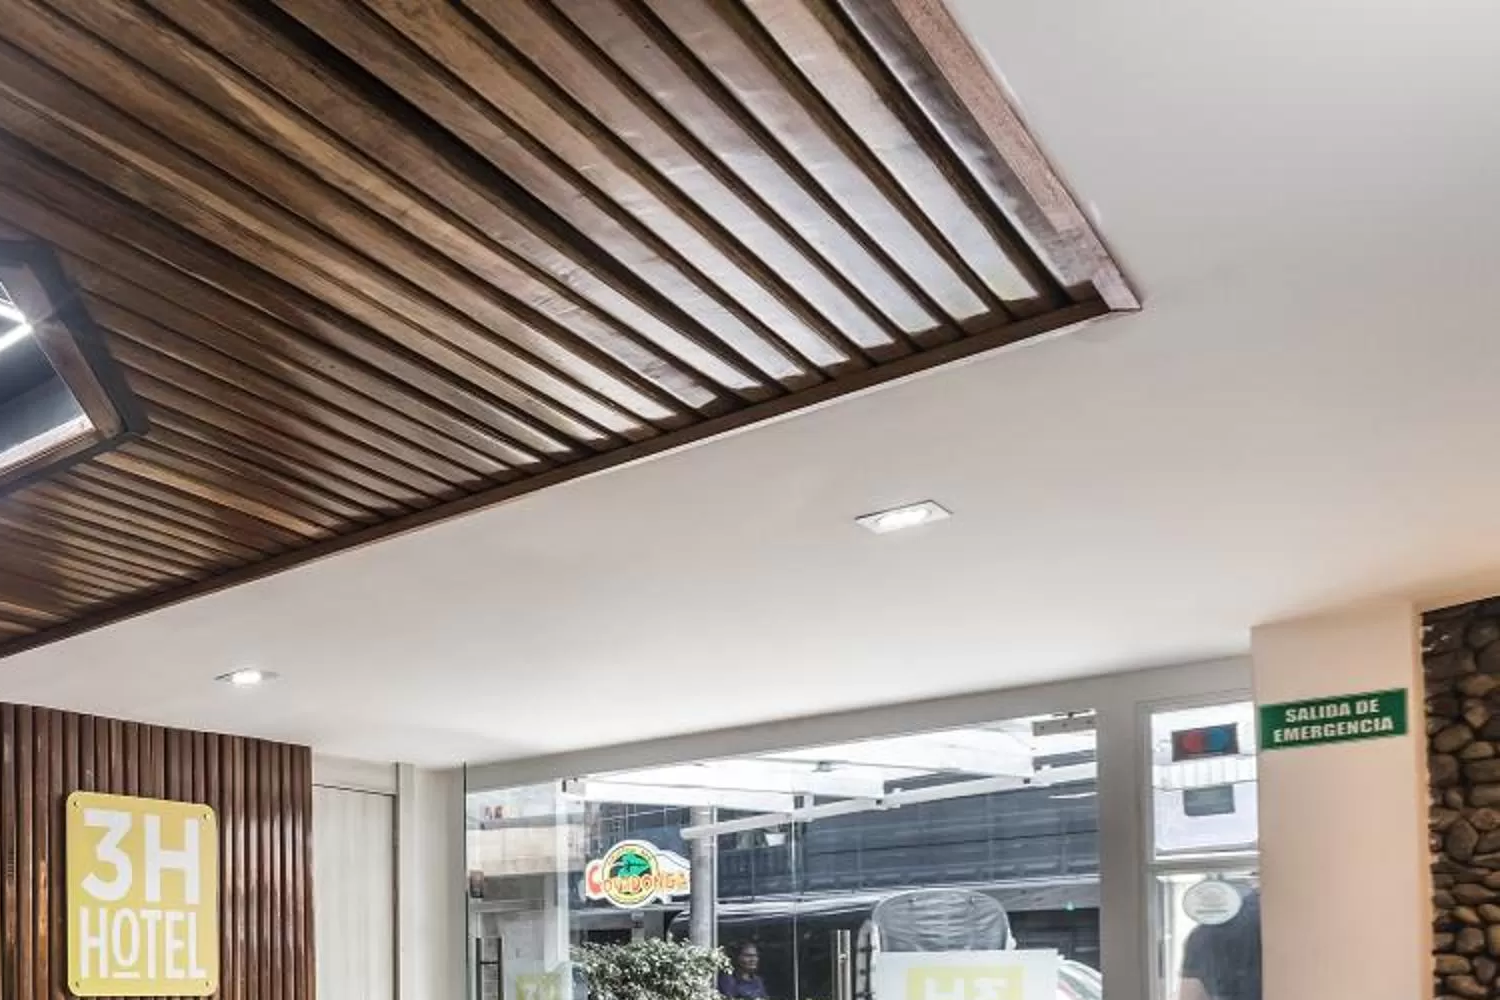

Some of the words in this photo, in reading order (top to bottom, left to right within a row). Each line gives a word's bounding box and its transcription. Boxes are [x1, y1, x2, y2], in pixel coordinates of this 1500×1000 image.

[1273, 715, 1394, 743] EMERGENCIA
[1285, 702, 1351, 723] SALIDA
[1355, 698, 1380, 715] DE
[80, 807, 200, 905] 3H
[79, 907, 207, 980] HOTEL
